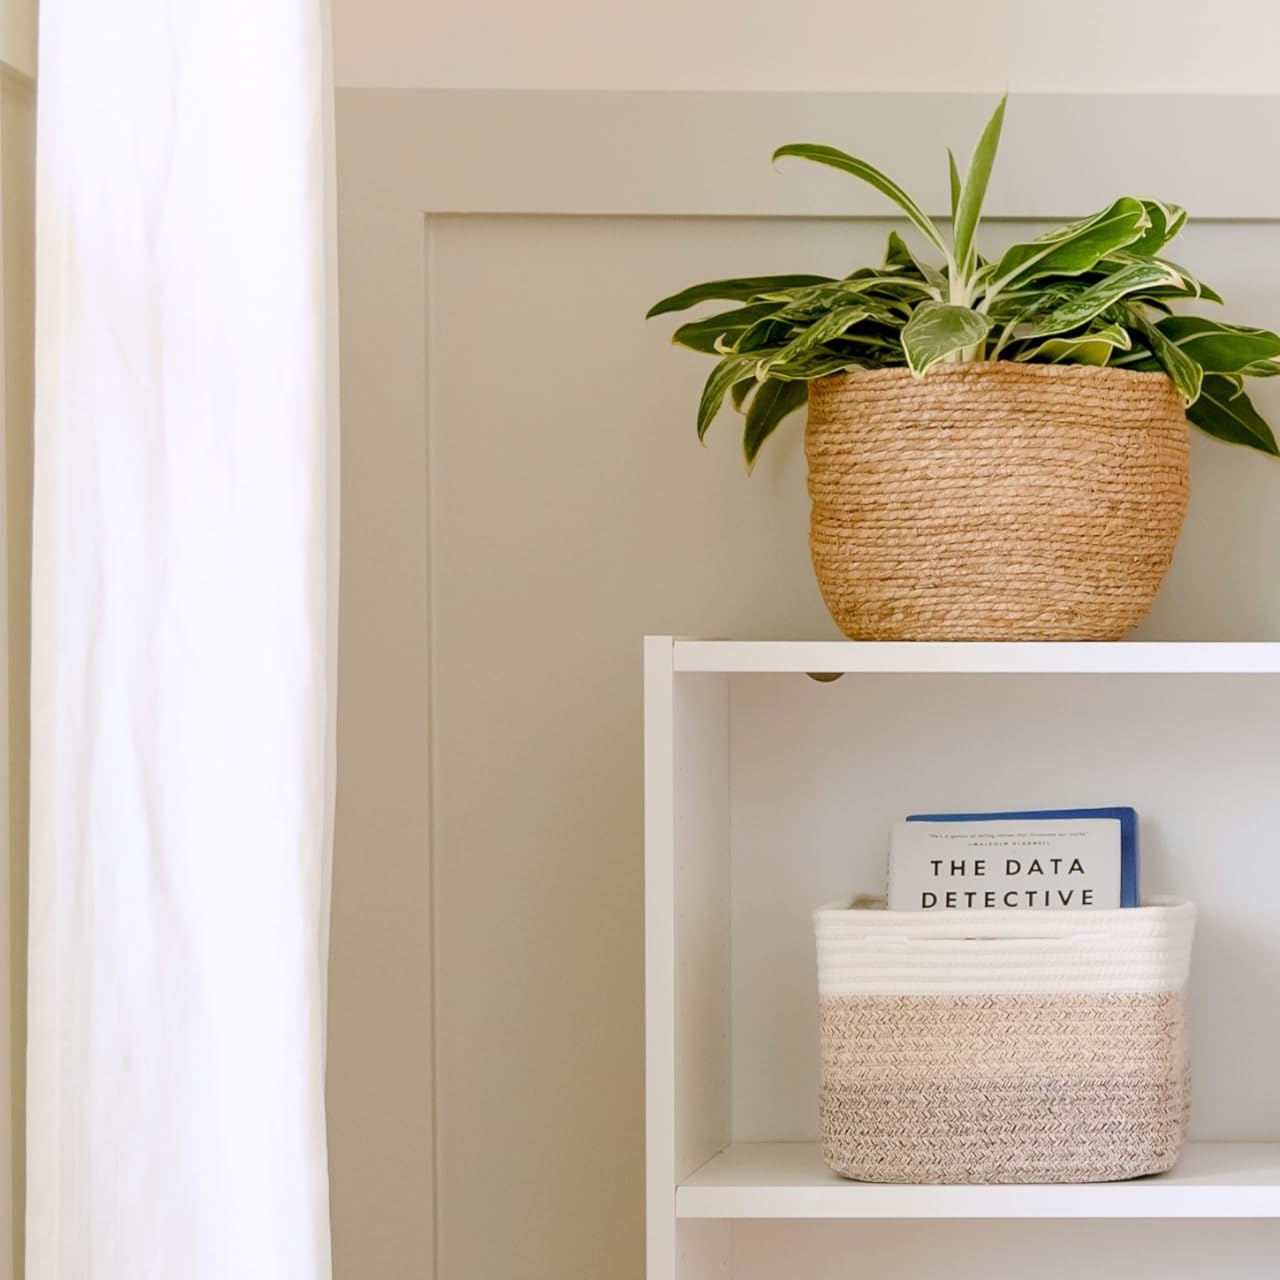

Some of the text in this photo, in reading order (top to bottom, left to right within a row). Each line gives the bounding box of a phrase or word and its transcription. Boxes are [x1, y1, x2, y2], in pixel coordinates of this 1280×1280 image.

[930, 858, 1085, 877] THE DATA
[921, 889, 1094, 909] DETECTIVE
